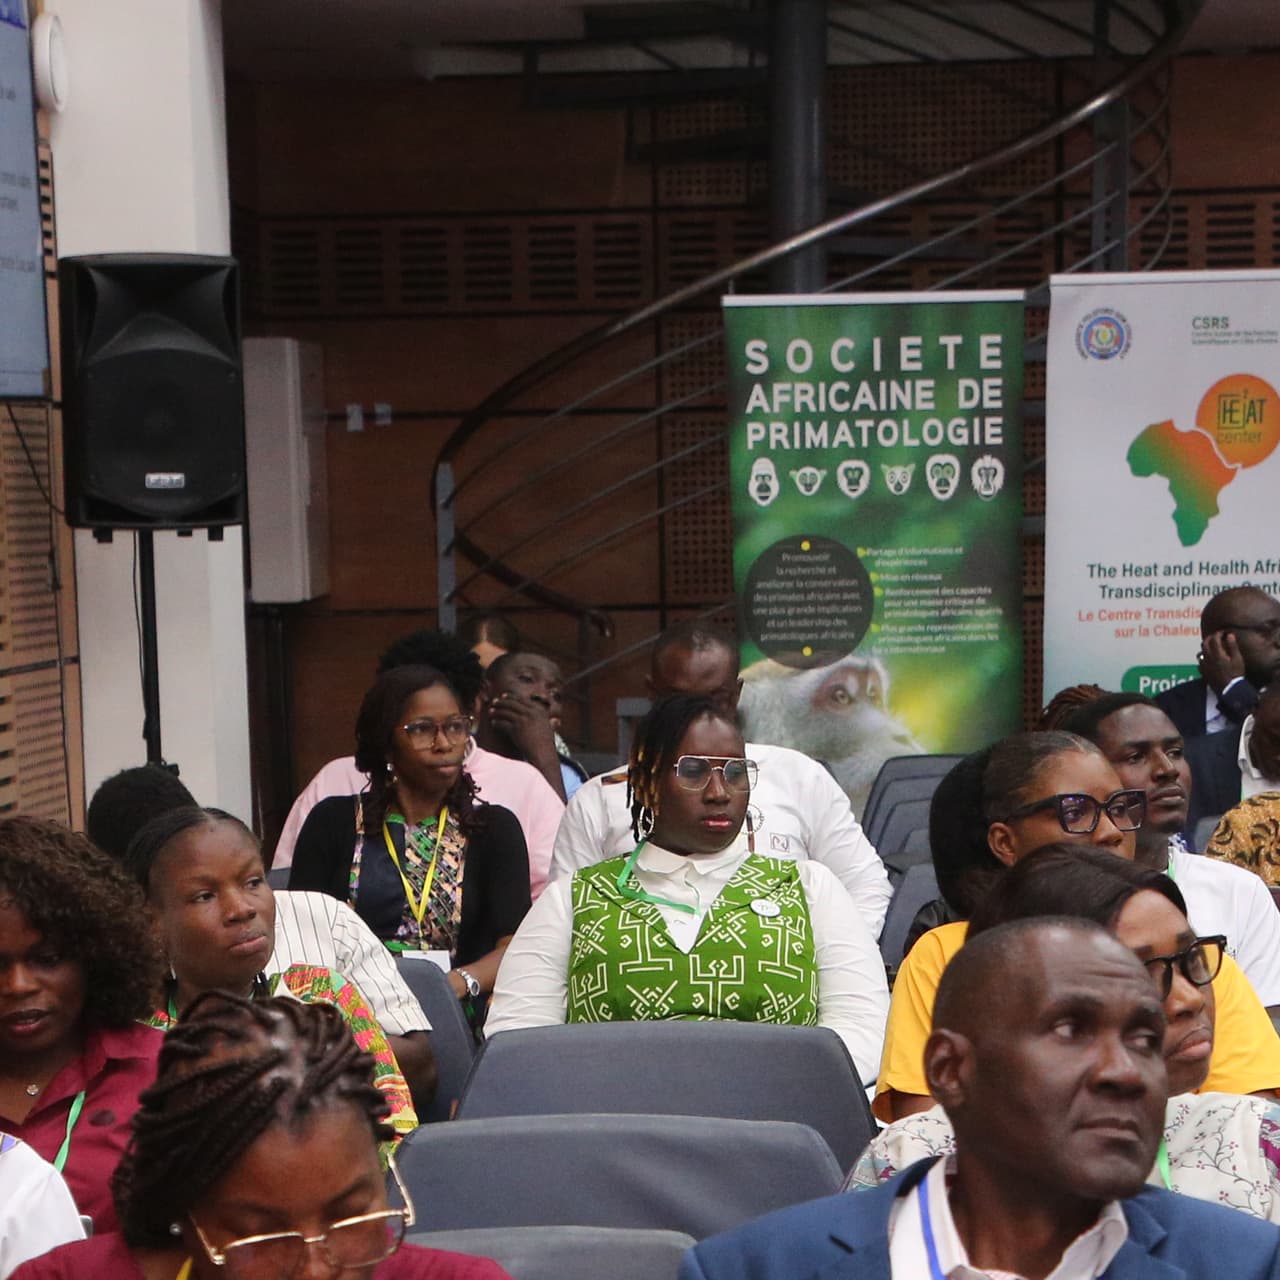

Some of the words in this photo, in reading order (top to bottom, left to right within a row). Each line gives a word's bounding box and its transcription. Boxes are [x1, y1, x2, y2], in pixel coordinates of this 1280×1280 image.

[1192, 316, 1229, 329] CSRS
[745, 334, 1003, 375] SOCIETE
[745, 378, 936, 414] AFRICAINE
[958, 377, 1004, 410] DE
[746, 416, 1004, 450] PRIMATOLOGIE
[1218, 430, 1262, 445] center
[782, 552, 830, 562] Promouvoir
[1086, 563, 1117, 578] The
[1122, 562, 1158, 578] Heat
[1163, 561, 1193, 576] and
[1199, 560, 1249, 576] Health
[1078, 609, 1094, 622] Le
[1098, 608, 1141, 621] Centre
[1145, 606, 1202, 620] Transdis
[1114, 628, 1135, 639] sur
[1138, 624, 1151, 638] la
[1153, 624, 1200, 637] Chaleu
